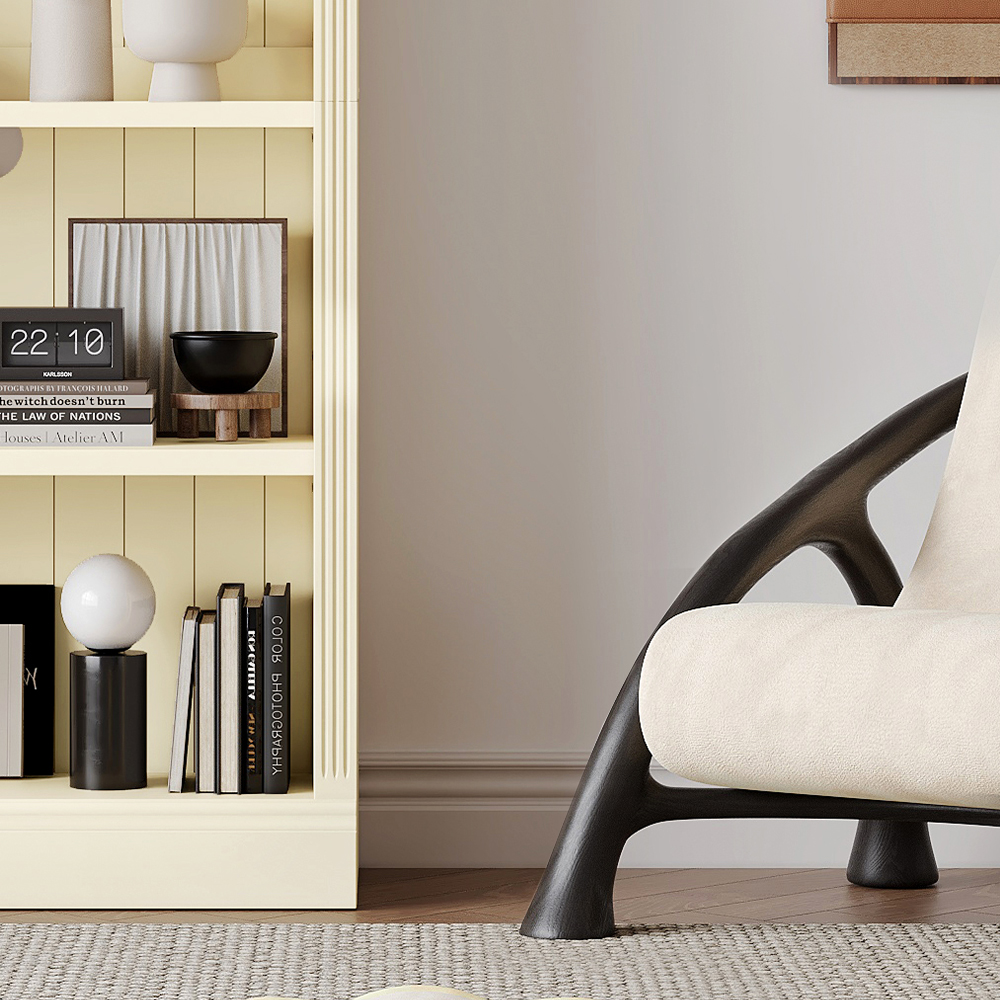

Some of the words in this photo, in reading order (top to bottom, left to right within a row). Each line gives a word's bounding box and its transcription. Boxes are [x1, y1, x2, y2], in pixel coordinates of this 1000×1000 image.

[10, 329, 49, 356] 22
[68, 328, 104, 356] 10
[45, 384, 55, 392] BY
[98, 384, 129, 392] HALARD
[13, 396, 49, 406] witch
[96, 396, 126, 406] burn
[21, 412, 47, 421] LAW
[49, 412, 67, 421] OF
[69, 412, 122, 421] NATIONS
[51, 430, 96, 444] Atelier
[97, 430, 125, 444] AM
